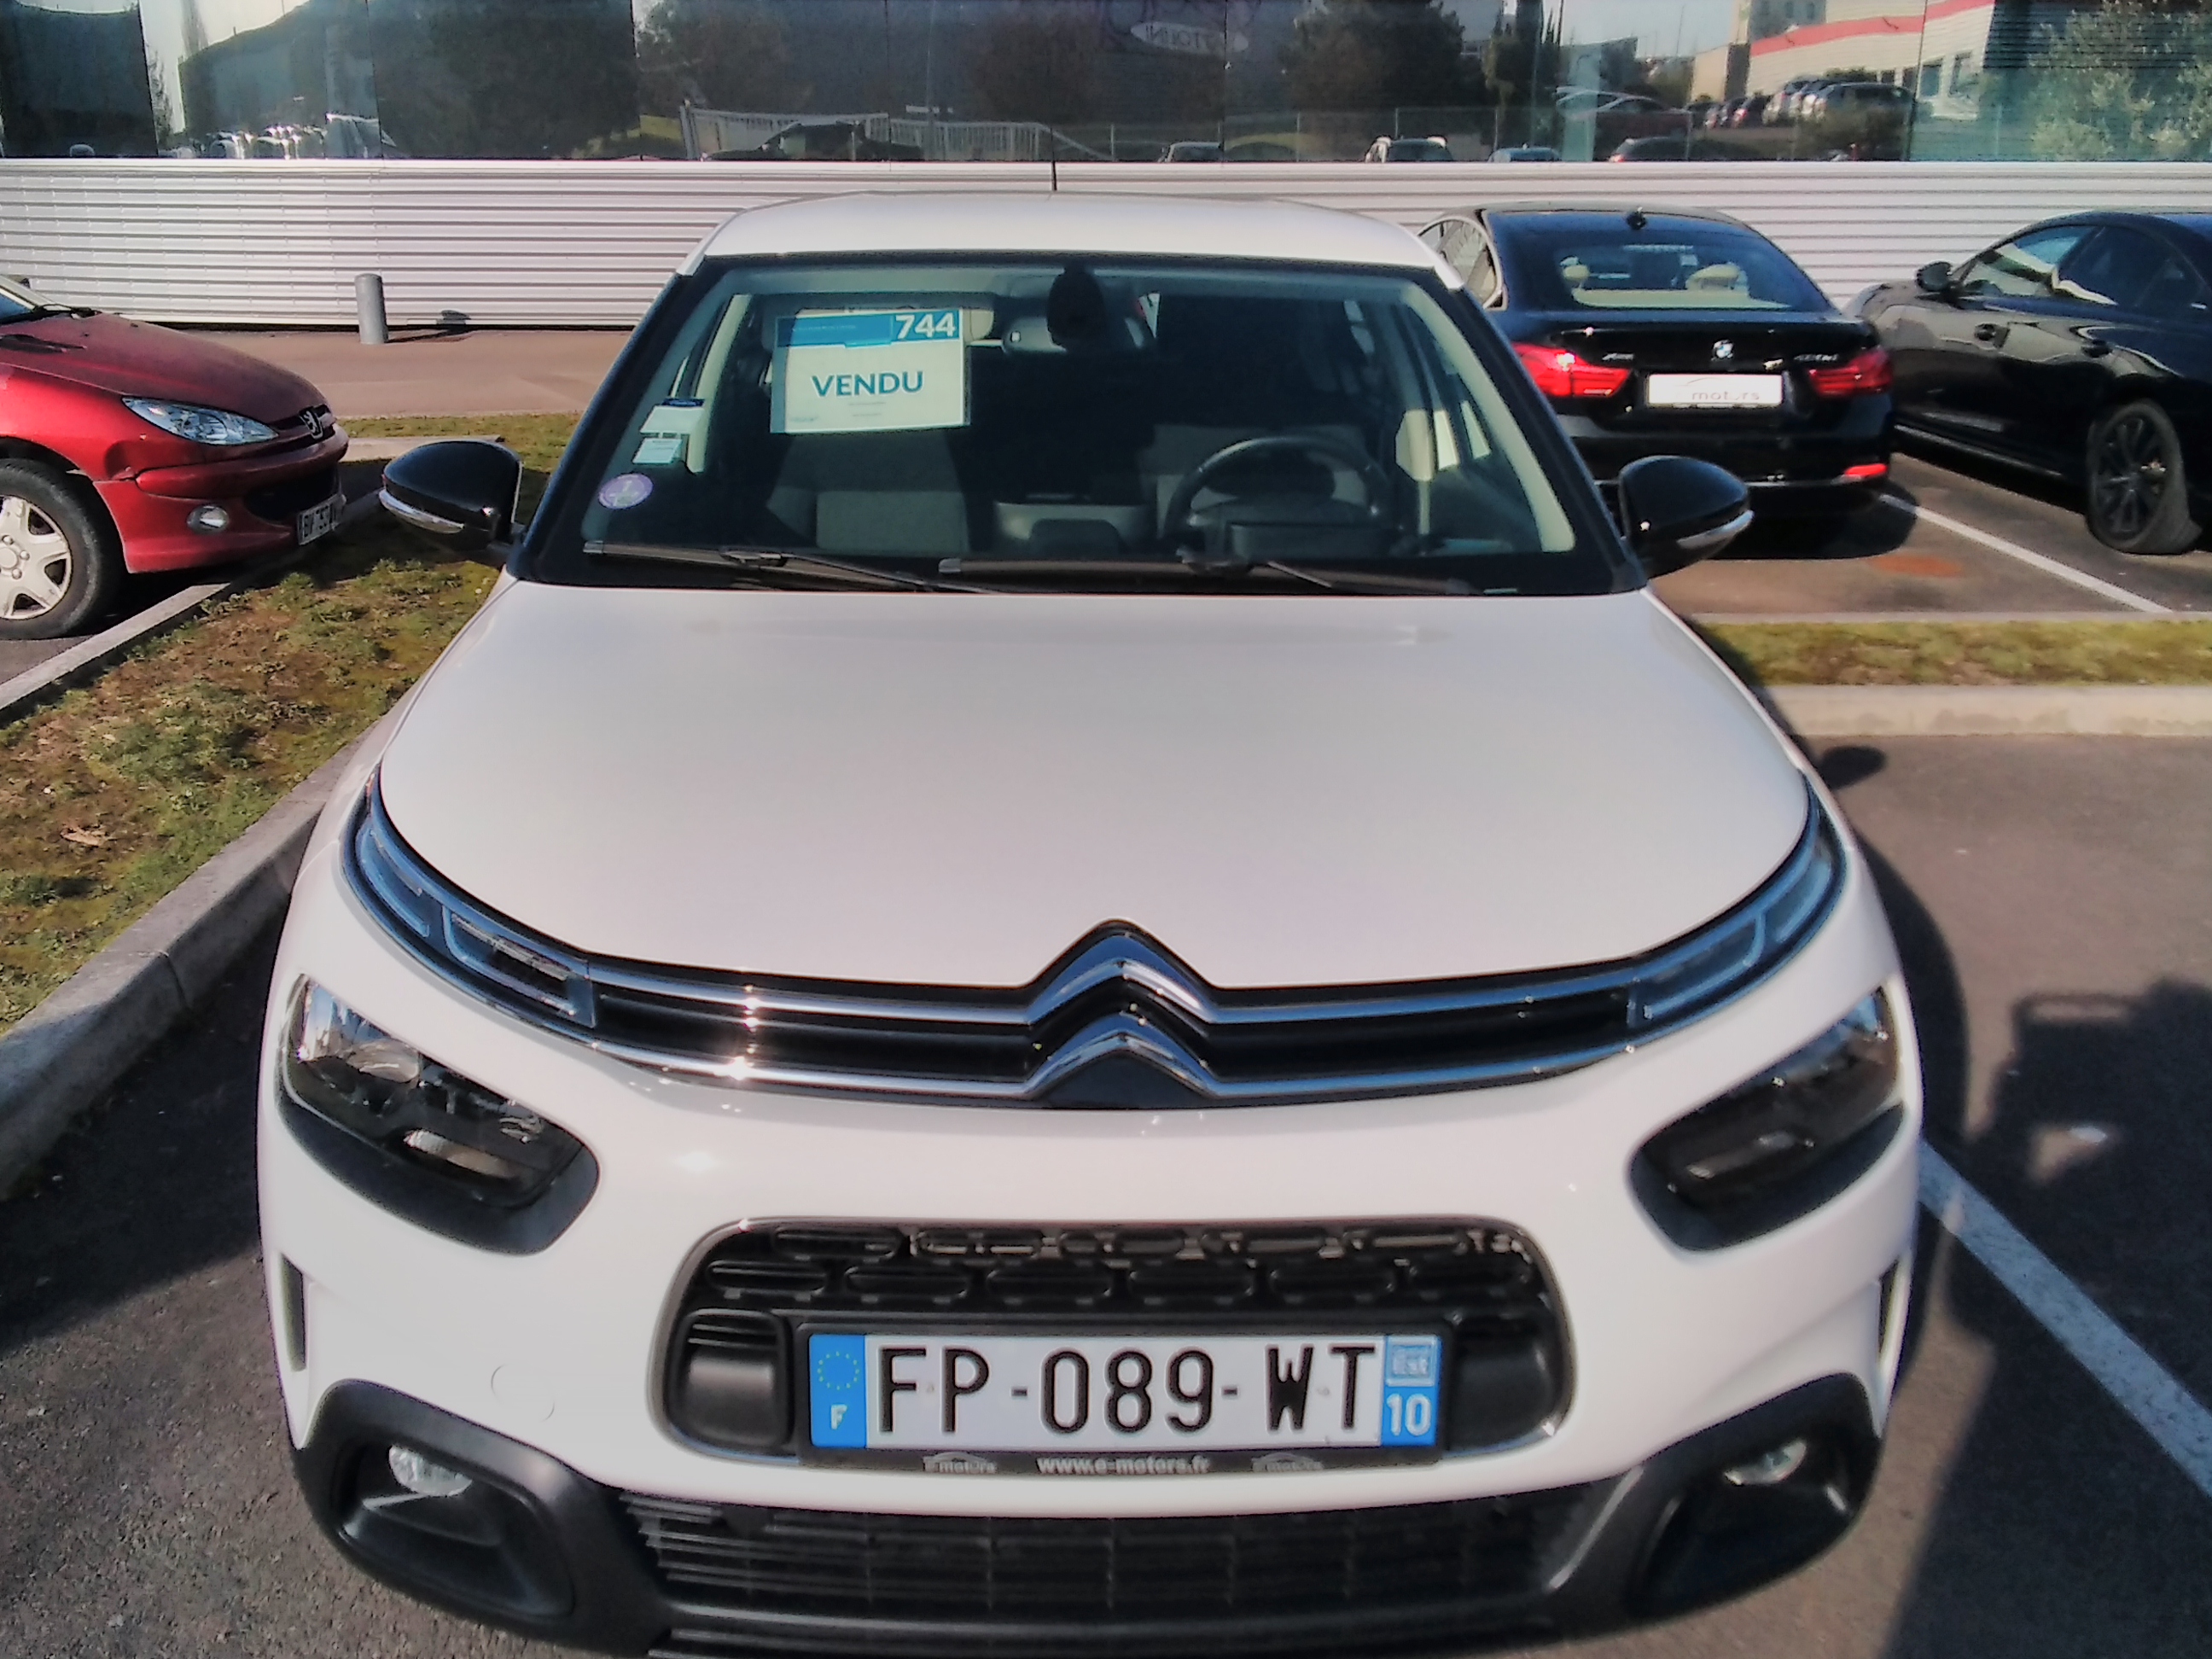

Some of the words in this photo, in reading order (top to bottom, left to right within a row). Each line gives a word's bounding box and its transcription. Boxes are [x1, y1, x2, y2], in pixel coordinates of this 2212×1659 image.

[896, 313, 956, 340] 744
[812, 370, 923, 398] VENDU
[880, 1345, 1376, 1435] FP-089-WT
[830, 1404, 848, 1429] F
[1386, 1393, 1432, 1436] 10
